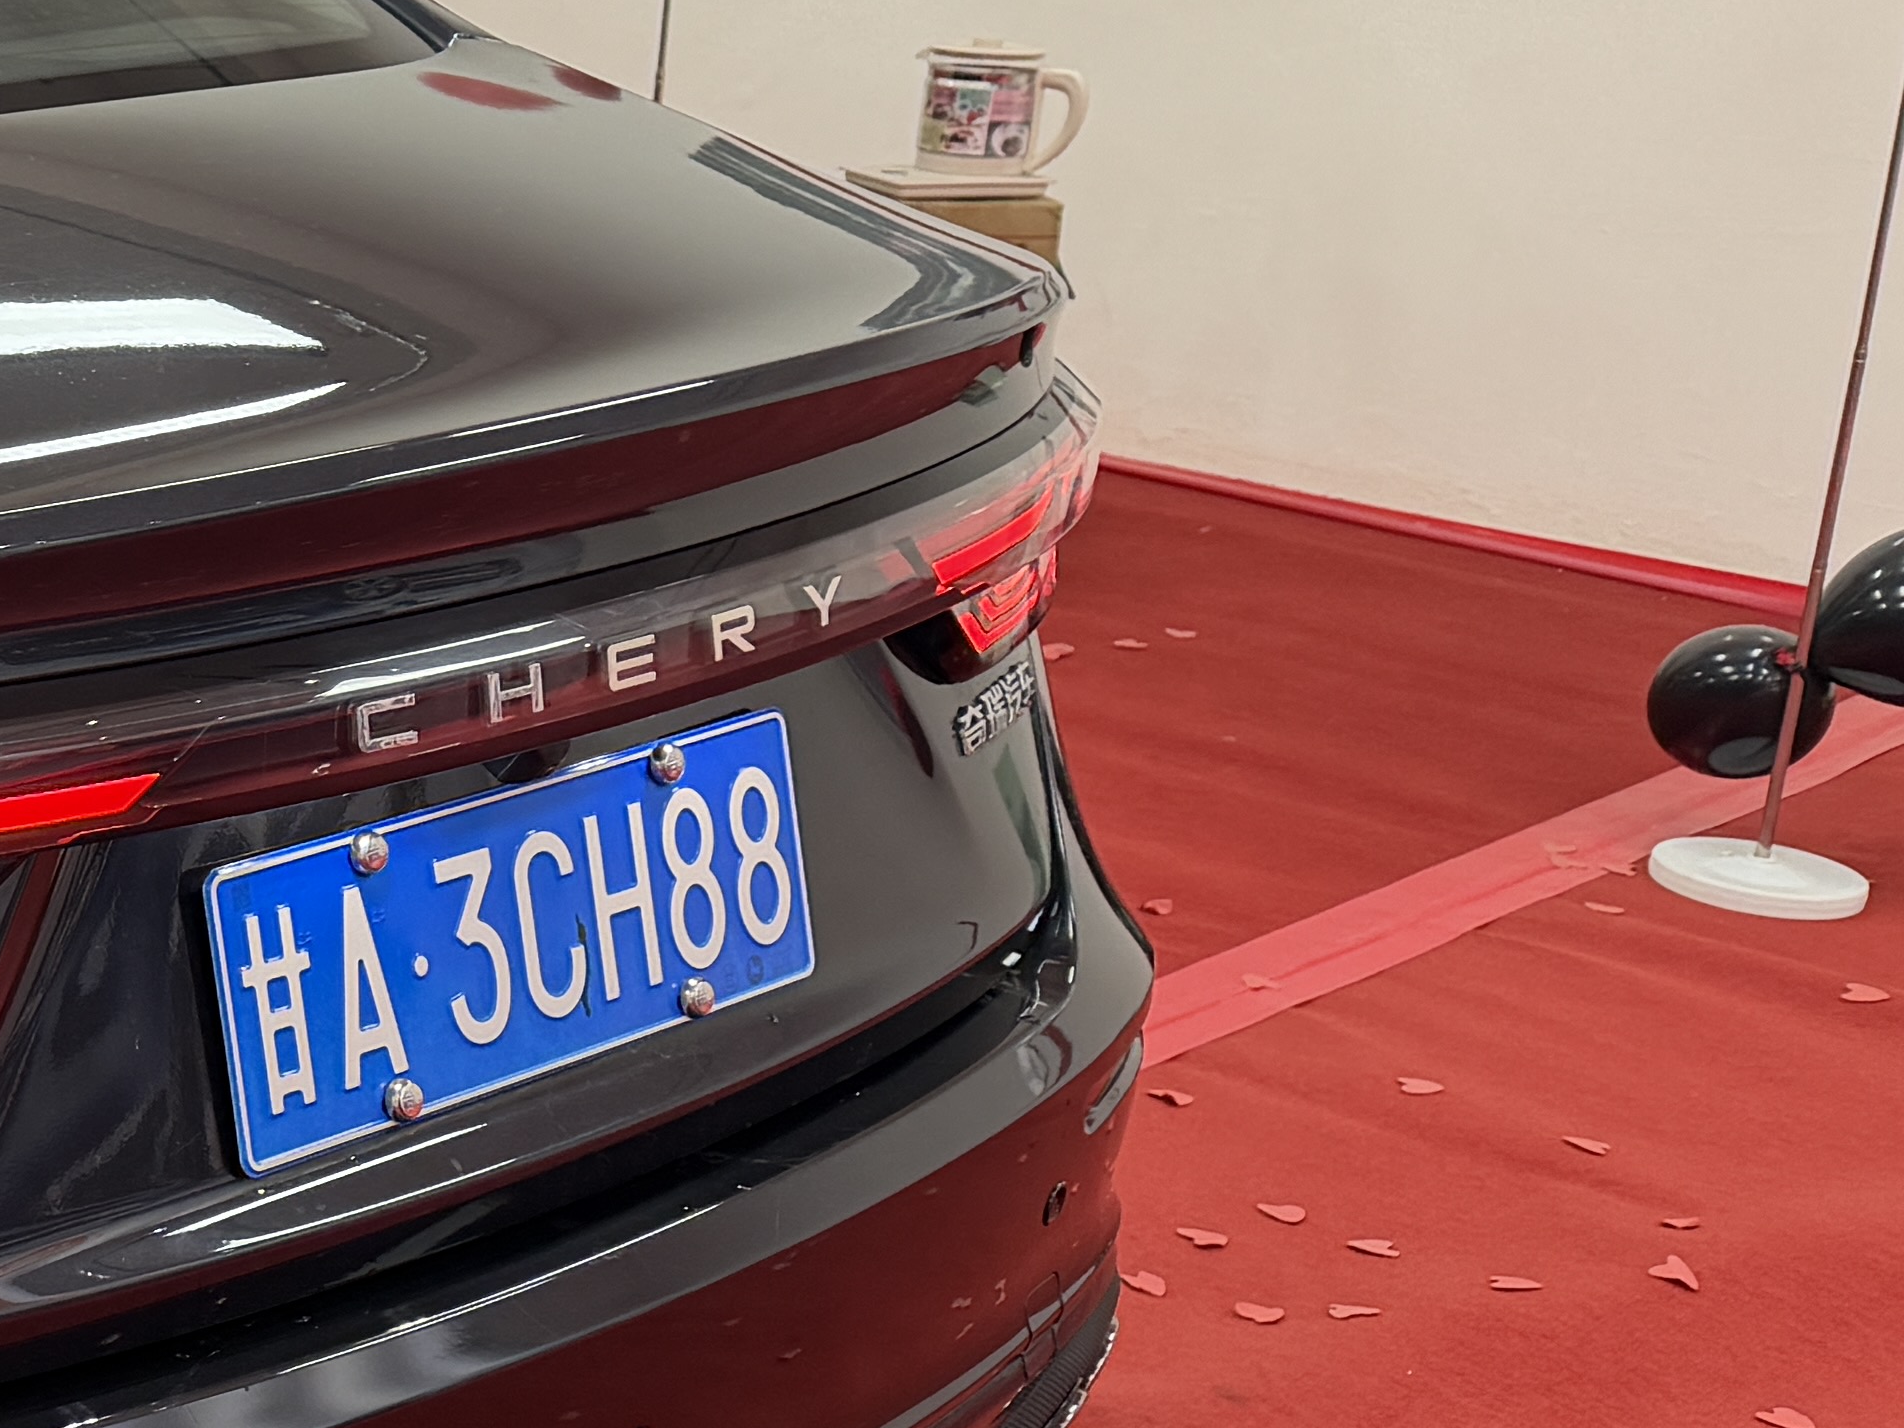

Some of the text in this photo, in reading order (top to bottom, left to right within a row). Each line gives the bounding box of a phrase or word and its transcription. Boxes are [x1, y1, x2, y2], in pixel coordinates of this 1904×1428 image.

[352, 575, 843, 755] CHERY
[956, 660, 1036, 757] 奇瑞汽车
